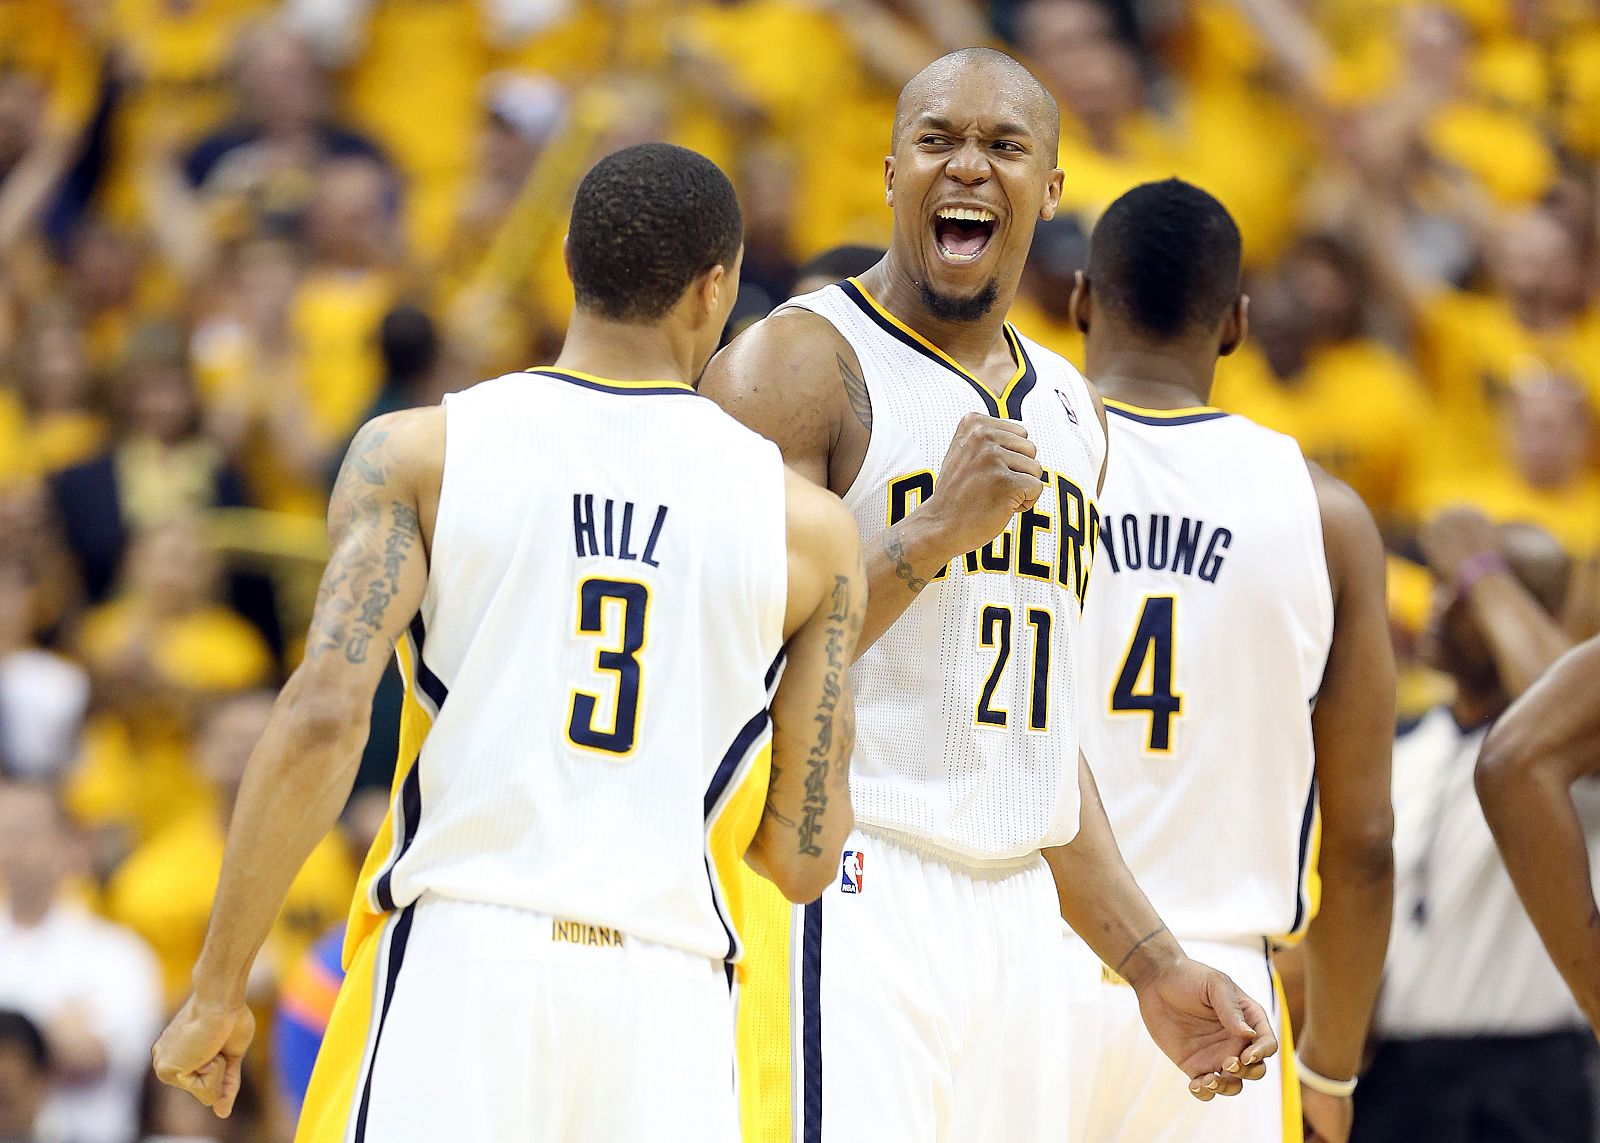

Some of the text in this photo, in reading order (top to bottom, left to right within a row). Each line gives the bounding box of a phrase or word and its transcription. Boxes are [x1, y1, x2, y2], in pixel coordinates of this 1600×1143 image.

[573, 493, 668, 568] HILL
[887, 465, 1099, 618] PERS
[1099, 513, 1232, 584] YOUNG
[564, 575, 651, 757] 3
[974, 602, 1053, 732] 21
[1108, 594, 1183, 753] 4
[552, 920, 624, 948] INDIANA
